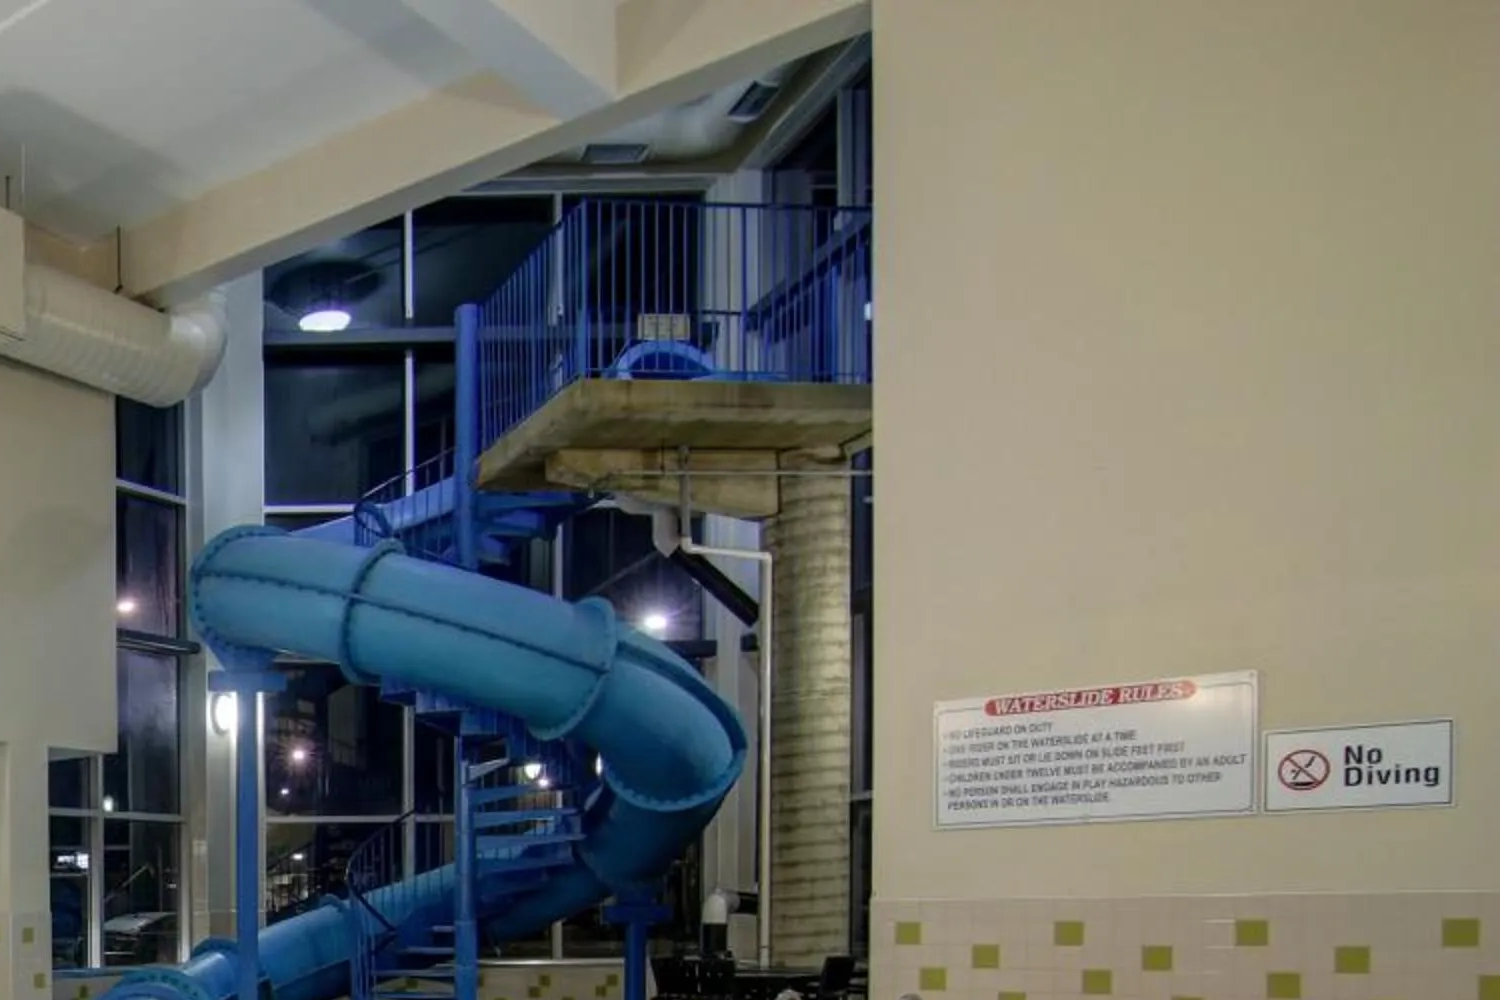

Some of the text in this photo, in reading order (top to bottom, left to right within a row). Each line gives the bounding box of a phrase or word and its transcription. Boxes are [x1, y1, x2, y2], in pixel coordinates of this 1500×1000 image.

[994, 683, 1183, 715] WATERSLIDE RULES
[963, 725, 1012, 739] LIFEGUARD
[1030, 722, 1053, 733] DUTY
[1031, 734, 1089, 748] WATERSLIDE
[1344, 745, 1382, 765] No
[1344, 764, 1440, 788] Diving
